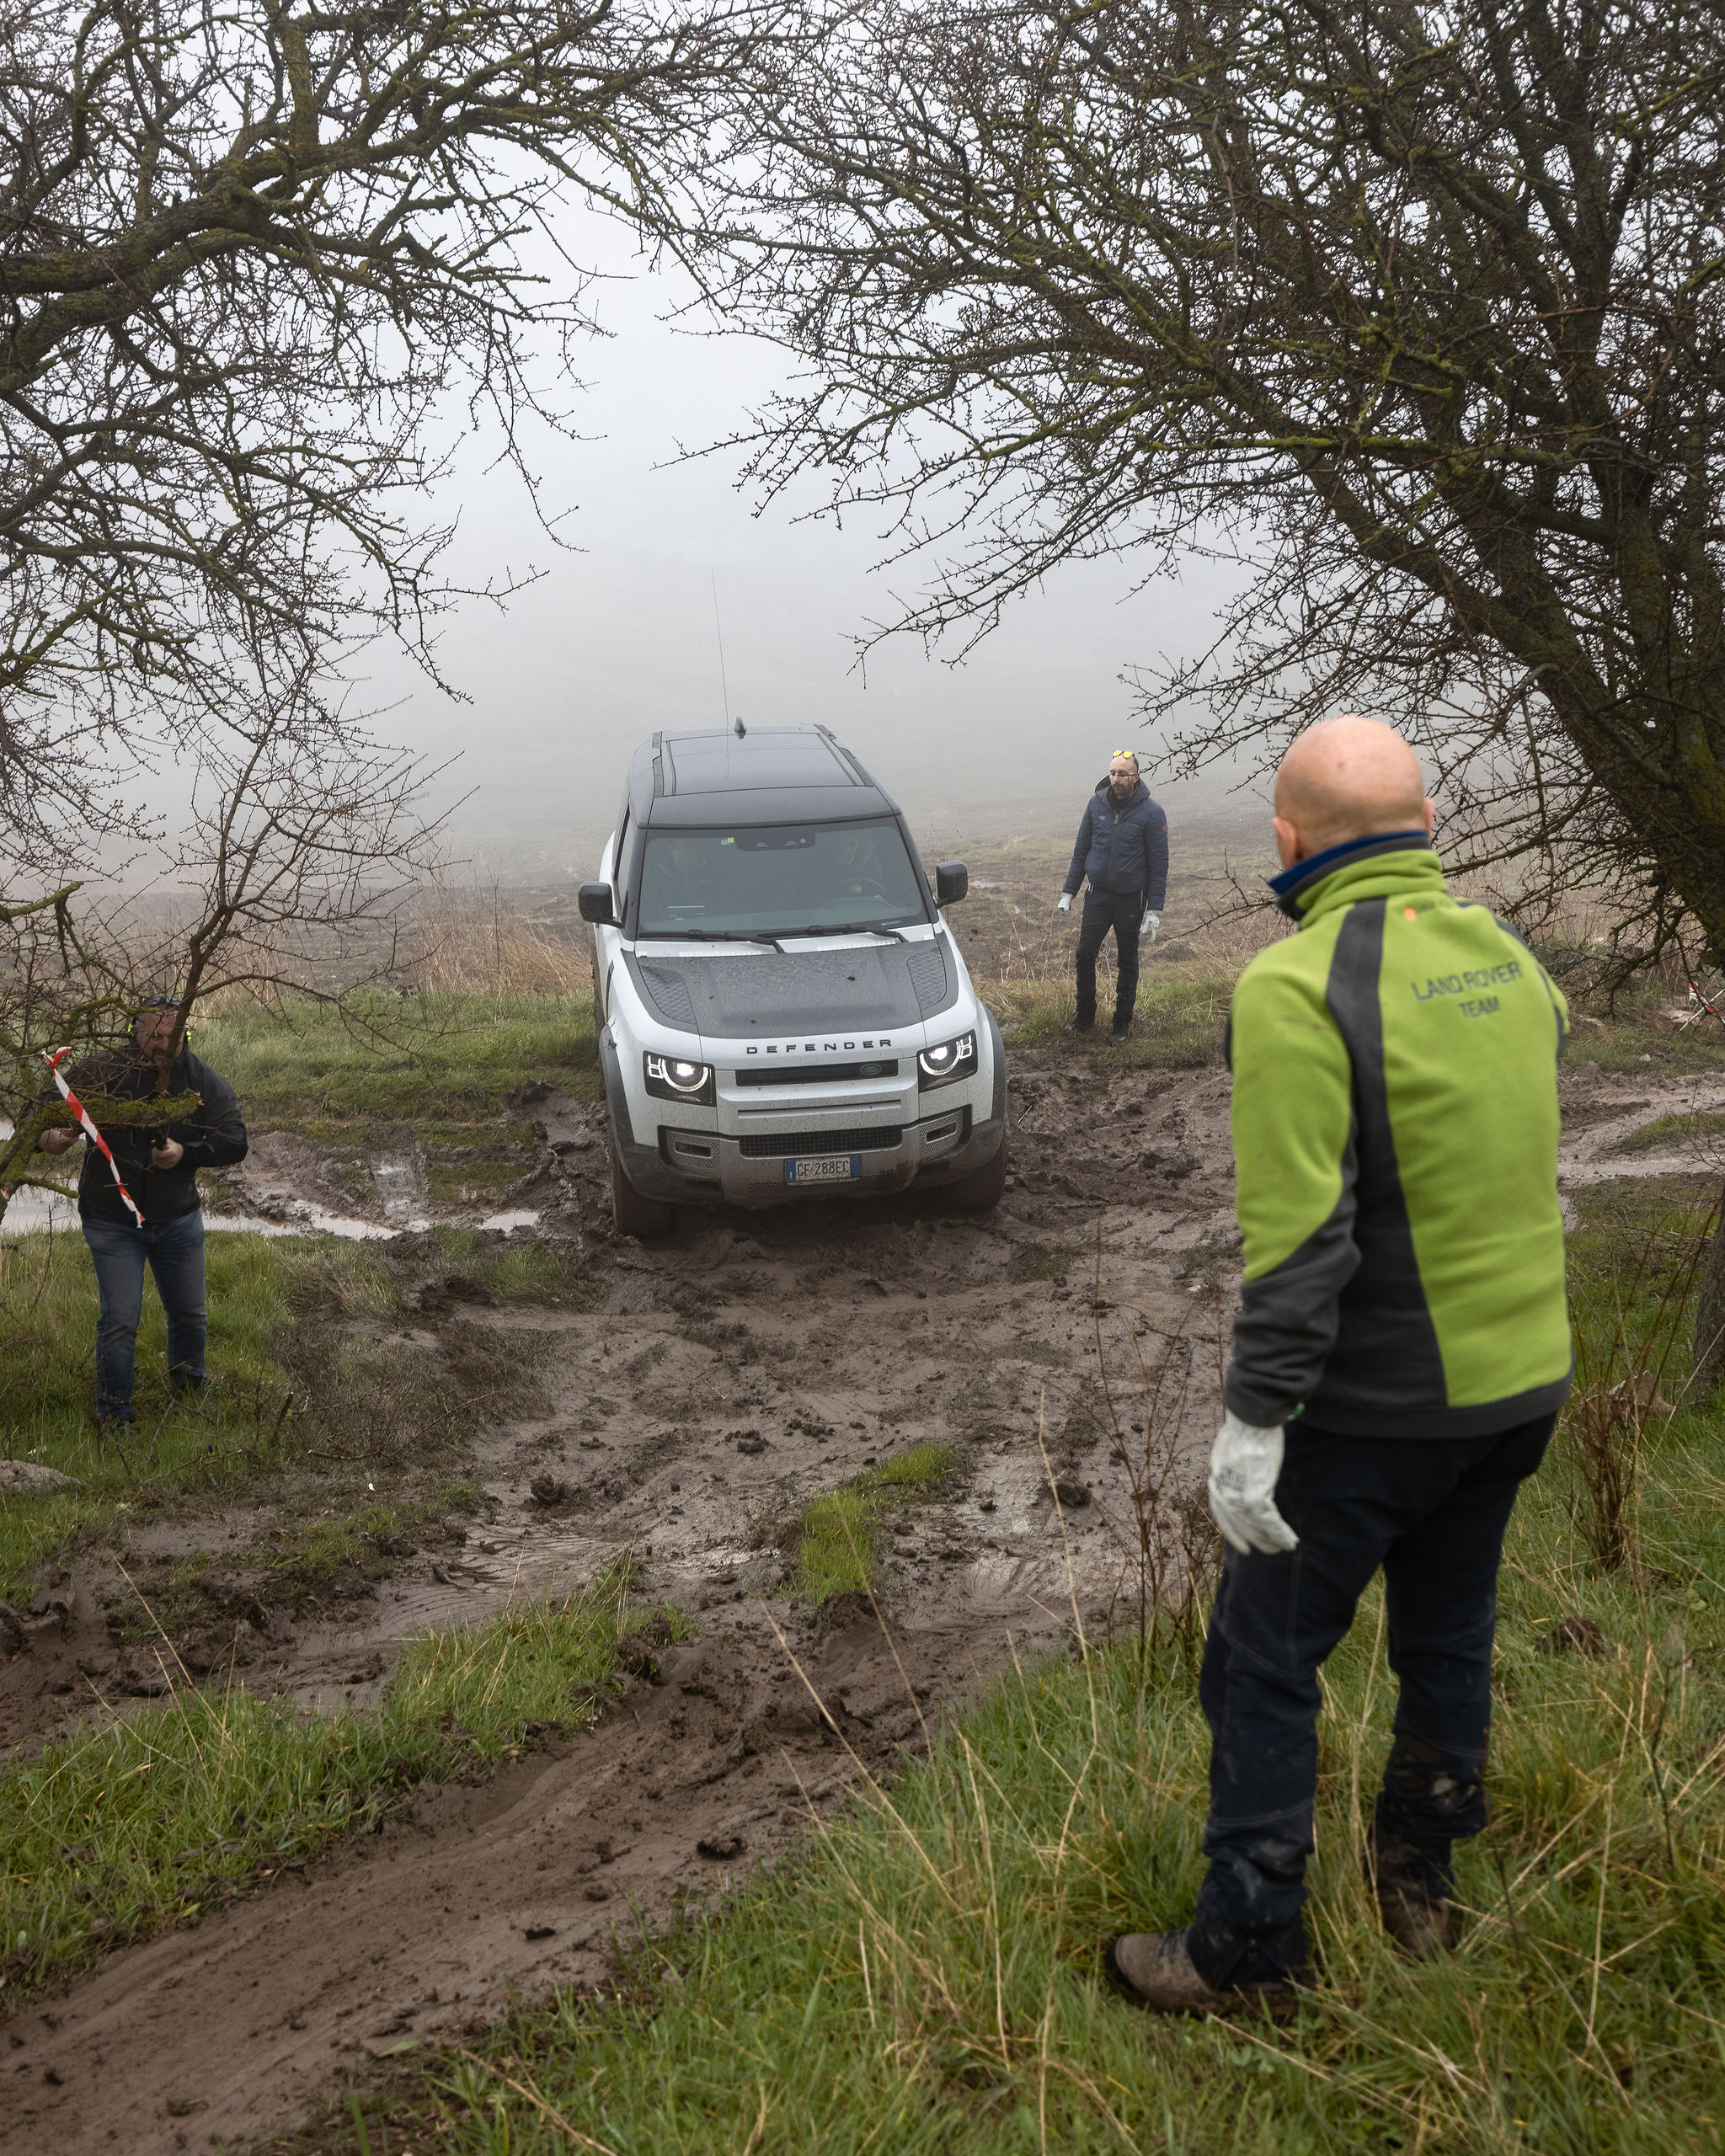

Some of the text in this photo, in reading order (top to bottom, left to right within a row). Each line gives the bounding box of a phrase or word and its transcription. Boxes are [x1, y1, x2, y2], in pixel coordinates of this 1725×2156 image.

[1411, 961, 1523, 1001] LAND ROVER
[1458, 996, 1501, 1018] TEAM
[746, 1039, 891, 1054] DEFENDER
